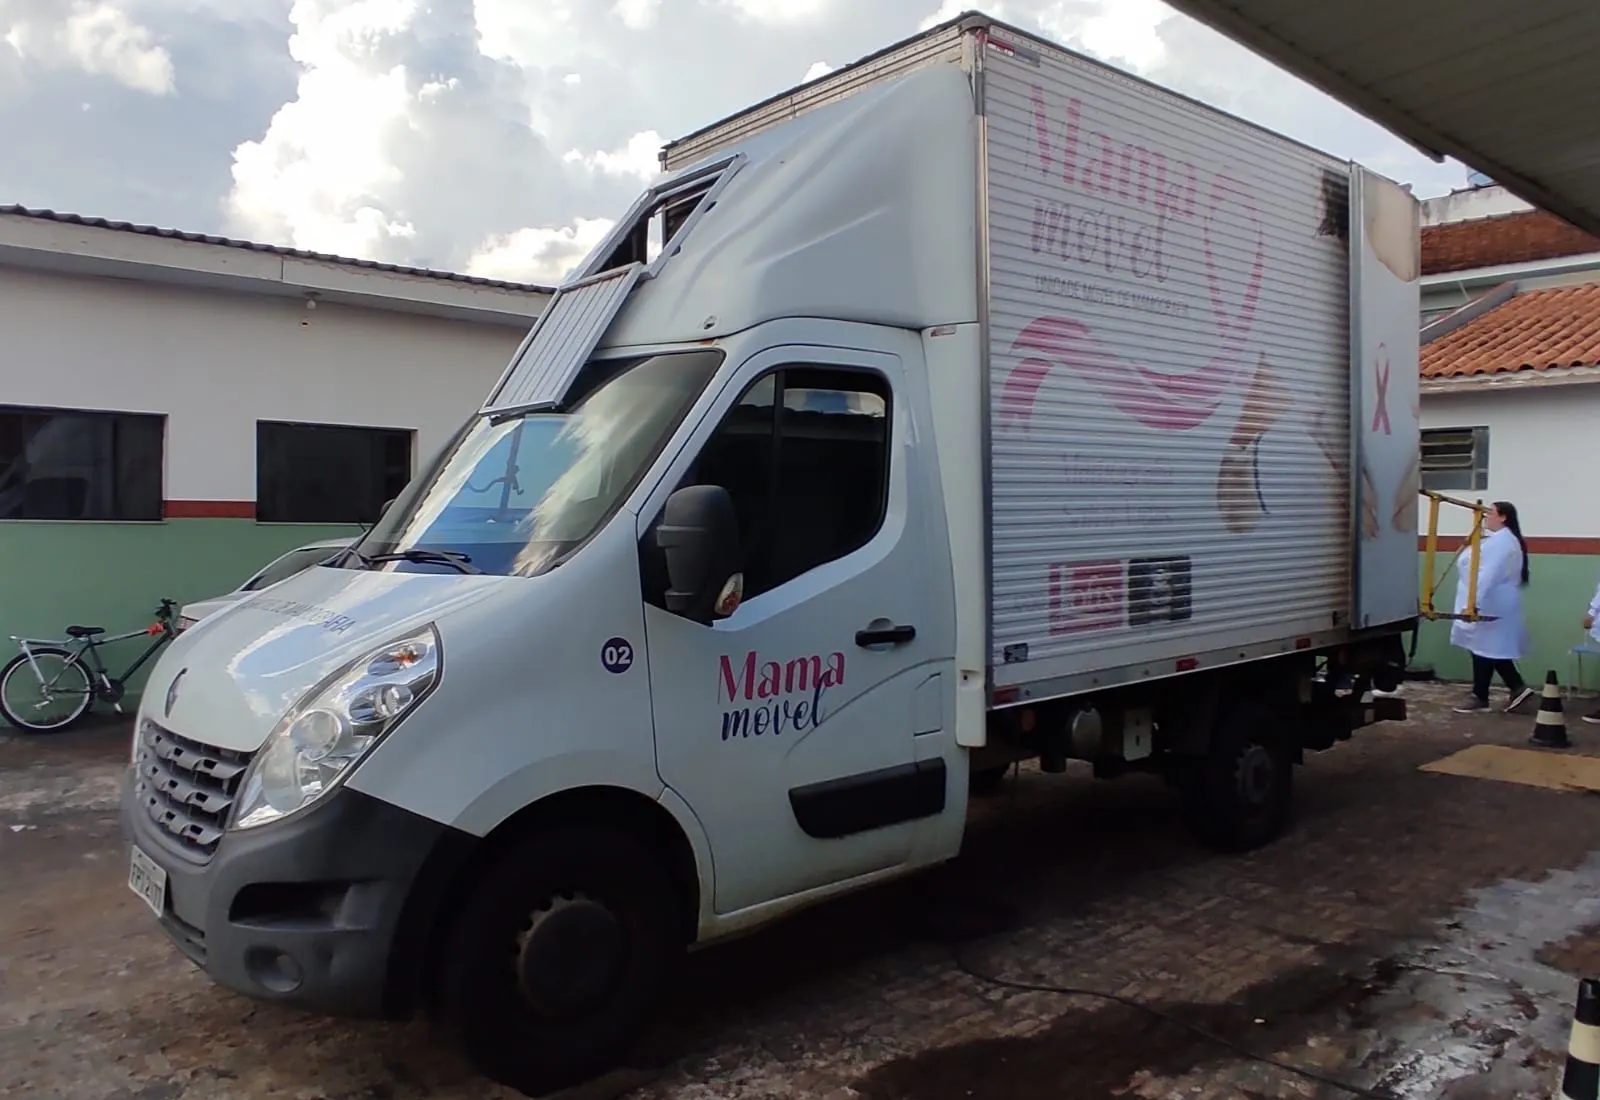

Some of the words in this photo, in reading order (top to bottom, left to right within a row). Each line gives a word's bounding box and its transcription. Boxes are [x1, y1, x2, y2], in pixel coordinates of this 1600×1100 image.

[1025, 84, 1197, 218] Mama
[604, 646, 631, 665] 02
[717, 651, 845, 705] Mama
[720, 673, 830, 741] móvel
